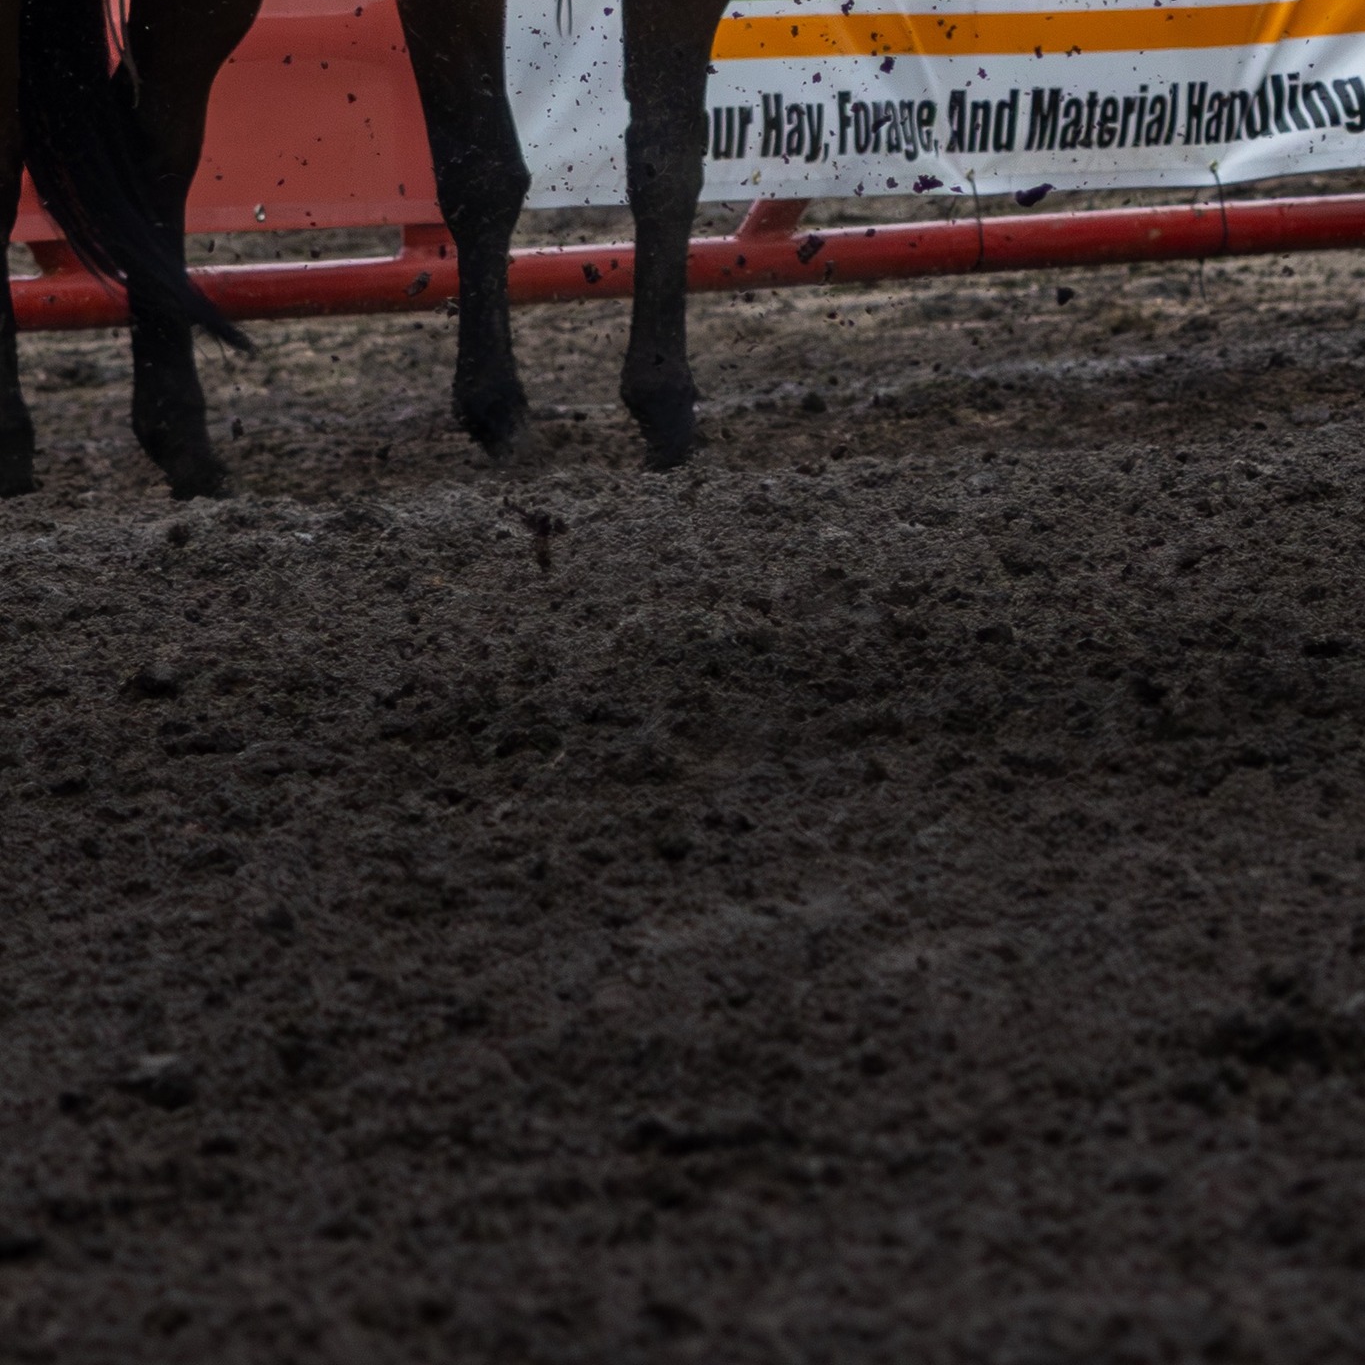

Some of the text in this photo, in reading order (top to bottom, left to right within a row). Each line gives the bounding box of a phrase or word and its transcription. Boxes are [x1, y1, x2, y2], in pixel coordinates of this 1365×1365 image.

[703, 105, 753, 160] ur
[760, 92, 830, 164] Hay,
[837, 90, 940, 162] Forage,
[946, 88, 1020, 155] And
[1024, 81, 1179, 152] Material
